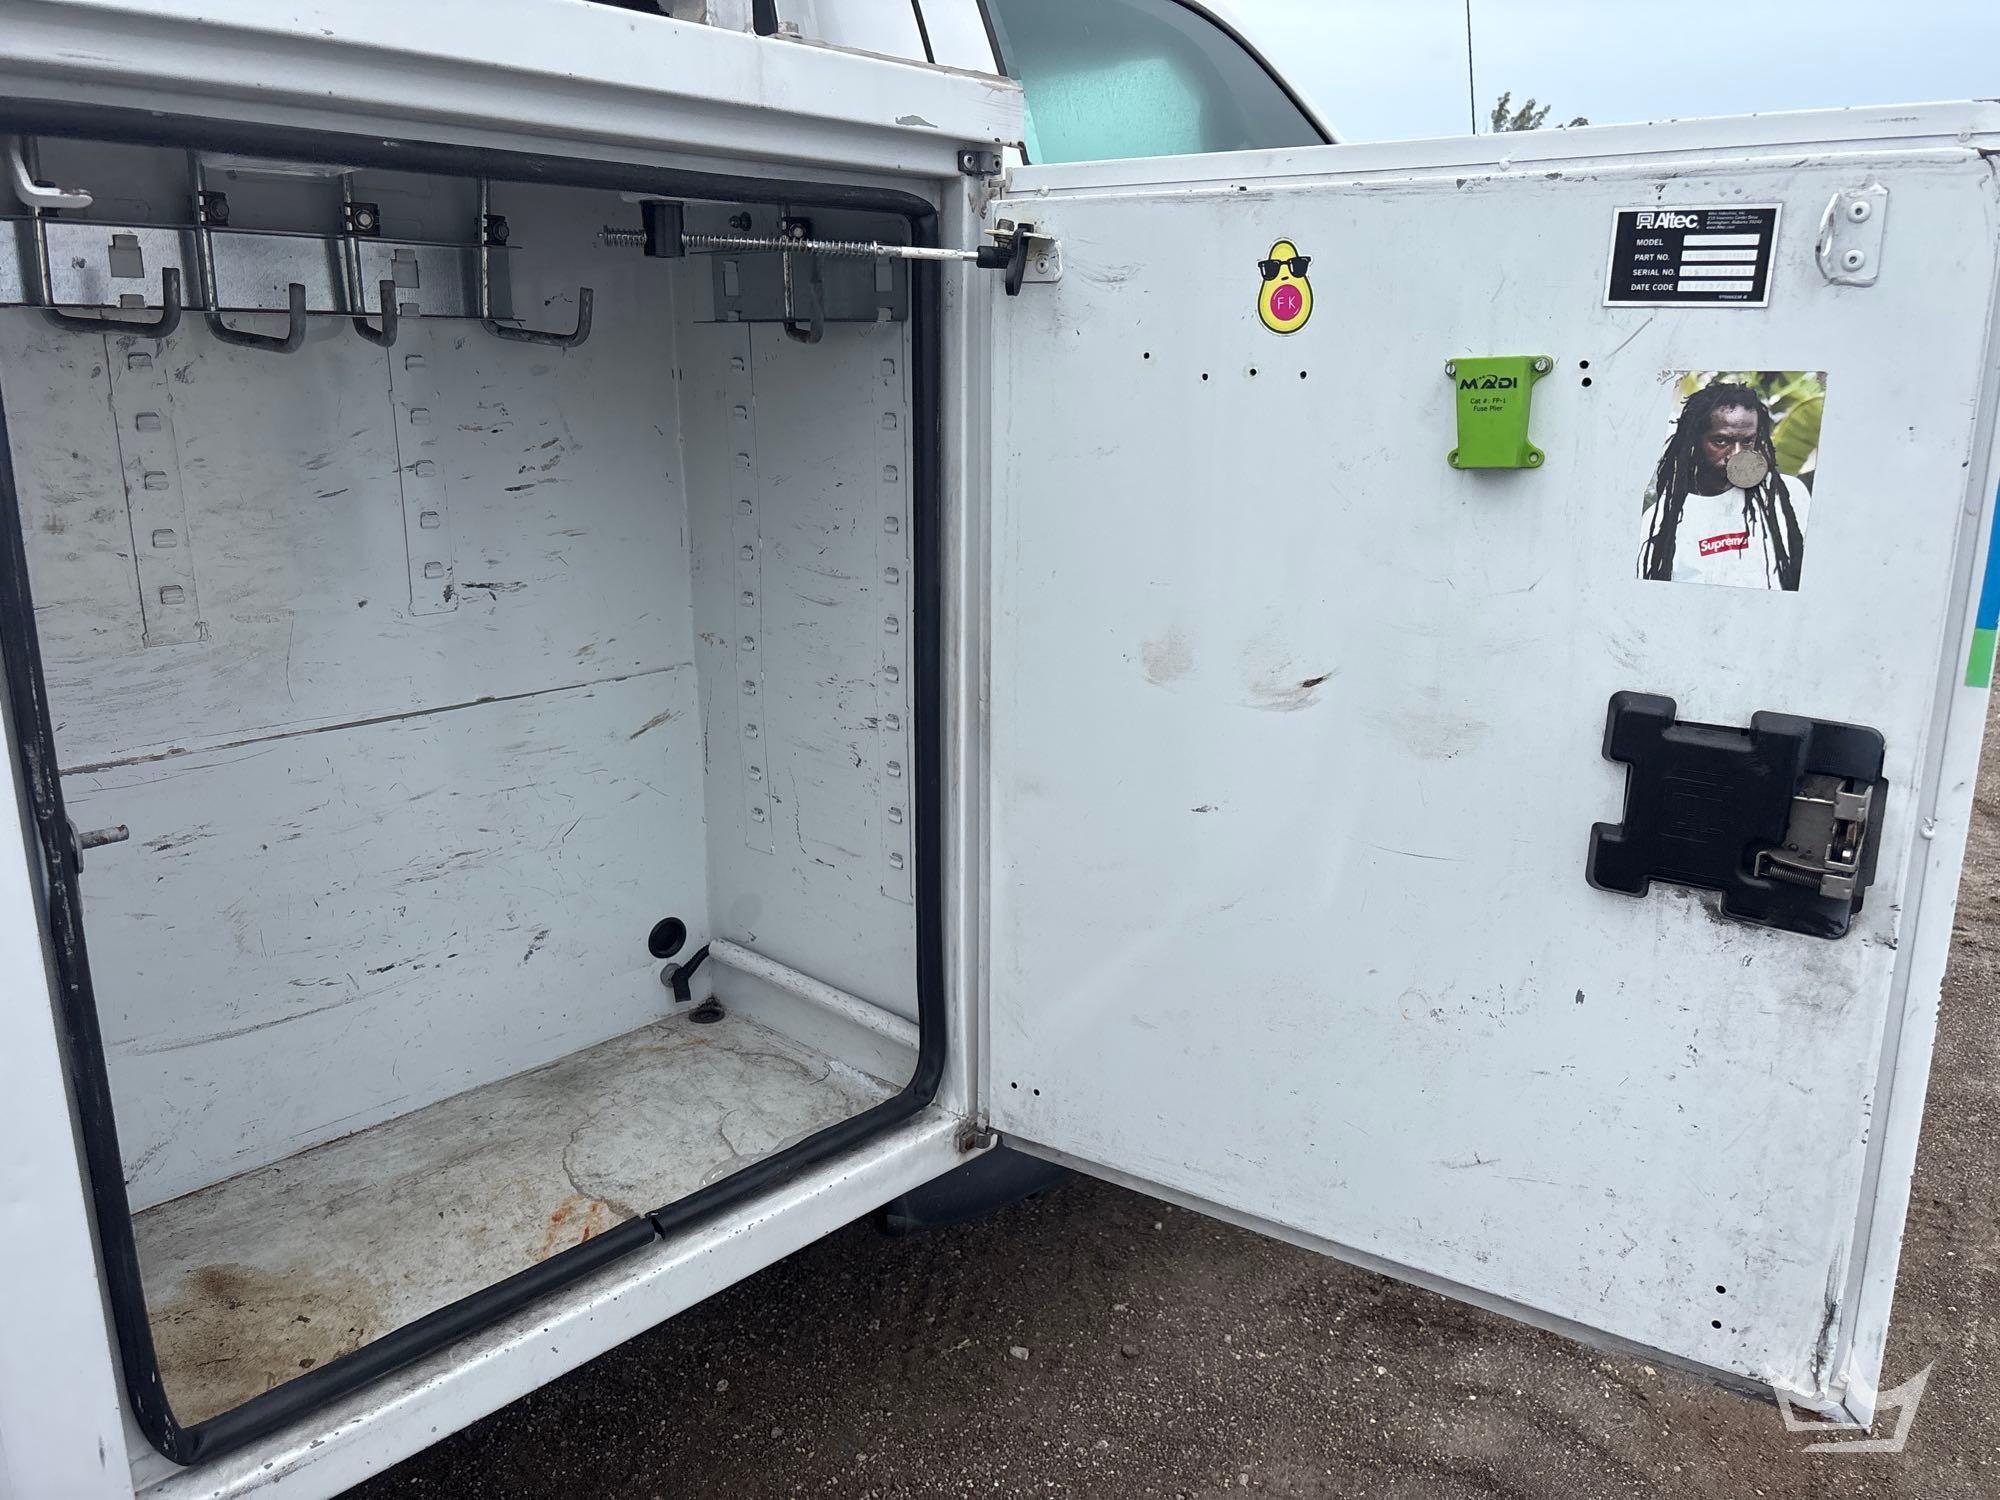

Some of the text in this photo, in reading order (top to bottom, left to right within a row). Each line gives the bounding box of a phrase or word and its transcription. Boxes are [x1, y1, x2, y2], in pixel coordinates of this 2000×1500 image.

[1653, 212, 1698, 229] Altec
[1636, 238, 1664, 246] MODEL
[1634, 253, 1670, 261] PART NO.
[1632, 268, 1660, 276] SERIAL
[1661, 268, 1676, 276] NO.
[1630, 283, 1651, 291] DATE
[1652, 283, 1674, 291] CODE
[1459, 374, 1518, 390] MADI
